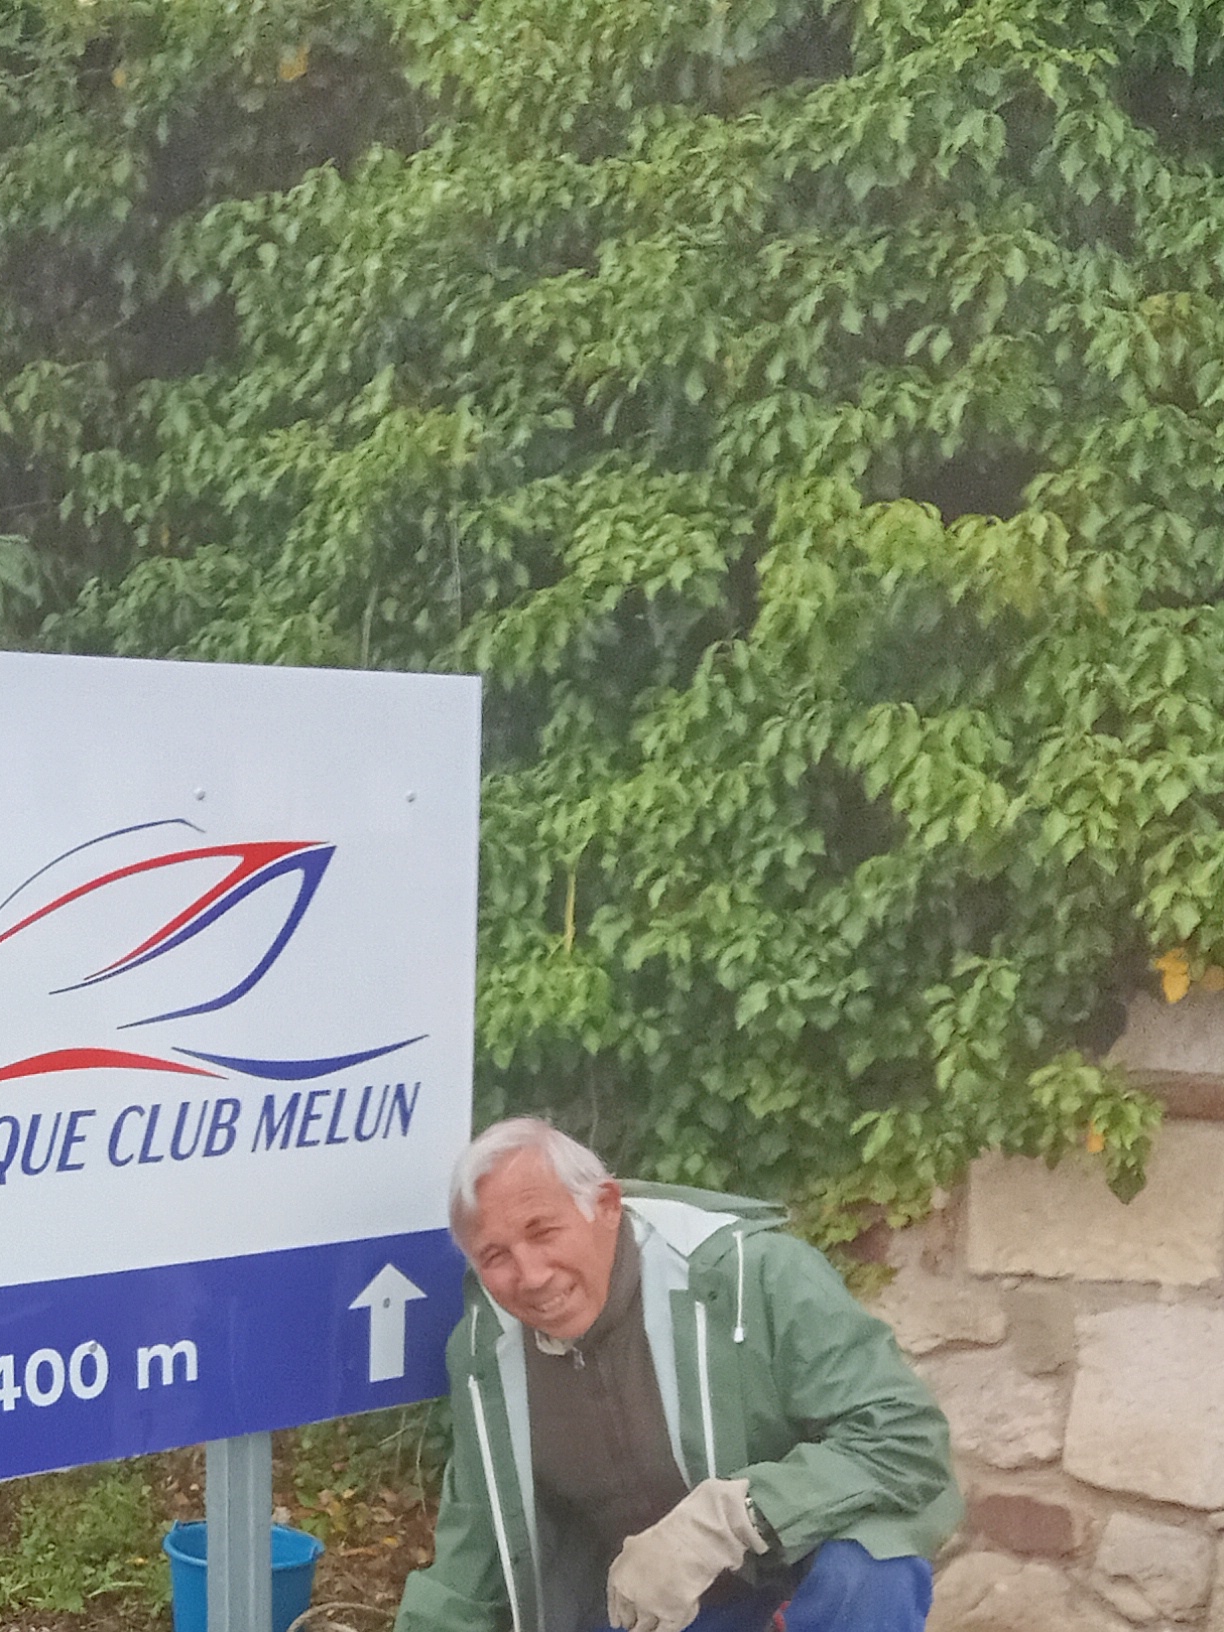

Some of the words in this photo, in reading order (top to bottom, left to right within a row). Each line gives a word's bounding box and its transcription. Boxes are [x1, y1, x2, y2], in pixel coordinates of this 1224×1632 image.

[109, 1098, 242, 1166] CLUB
[251, 1082, 421, 1154] MELUN
[136, 1339, 198, 1391] m
